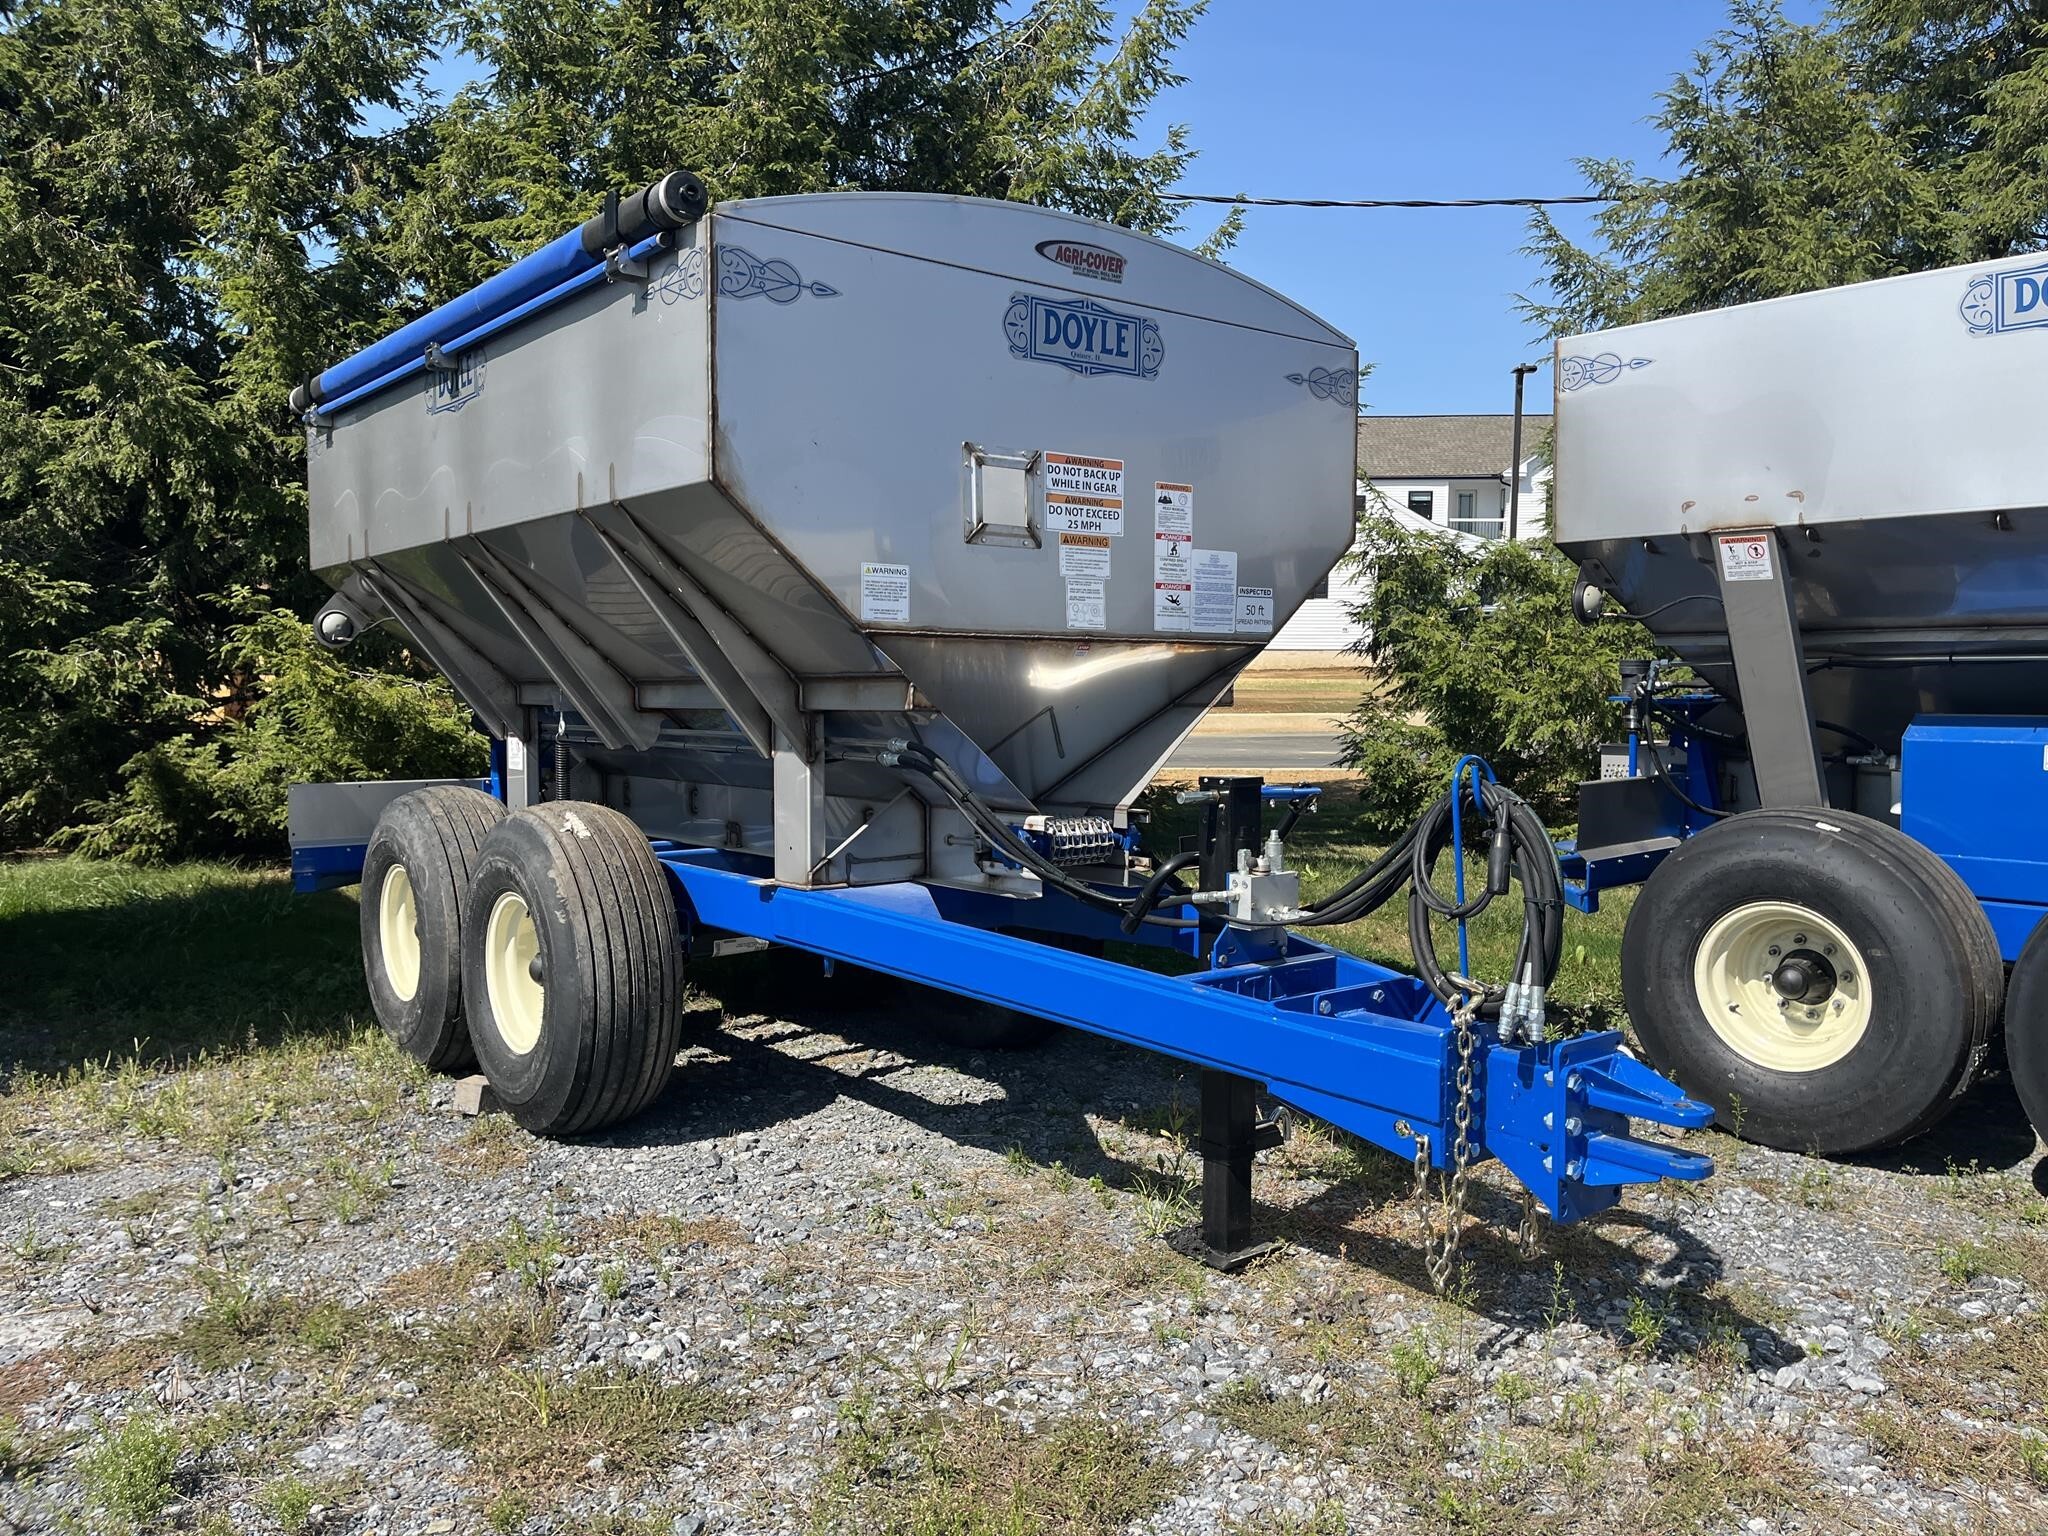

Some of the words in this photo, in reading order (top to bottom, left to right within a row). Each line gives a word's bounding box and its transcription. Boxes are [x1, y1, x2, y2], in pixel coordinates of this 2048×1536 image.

[1055, 245, 1123, 274] AGRI-COVER
[1043, 308, 1129, 358] DOYLE
[1070, 457, 1105, 468] WARNING
[1047, 464, 1061, 475] DO
[1063, 466, 1081, 477] NOT
[1083, 468, 1107, 480] BACK
[1109, 472, 1121, 481] UP
[1051, 478, 1080, 489] WHILE
[1082, 481, 1091, 490] IN
[1093, 482, 1117, 493] GEAR
[1070, 496, 1104, 507] WARNING
[1048, 505, 1063, 515] DO
[1065, 506, 1084, 517] NOT
[1086, 508, 1120, 520] EXCEED
[1067, 520, 1078, 529] 25
[1080, 521, 1101, 531] MPH
[1069, 536, 1108, 547] WARNING
[871, 567, 907, 576] WARNING
[1164, 583, 1187, 591] DANGER
[1239, 587, 1272, 596] INSPECTED
[1246, 604, 1256, 616] 50
[1258, 604, 1265, 616] ft
